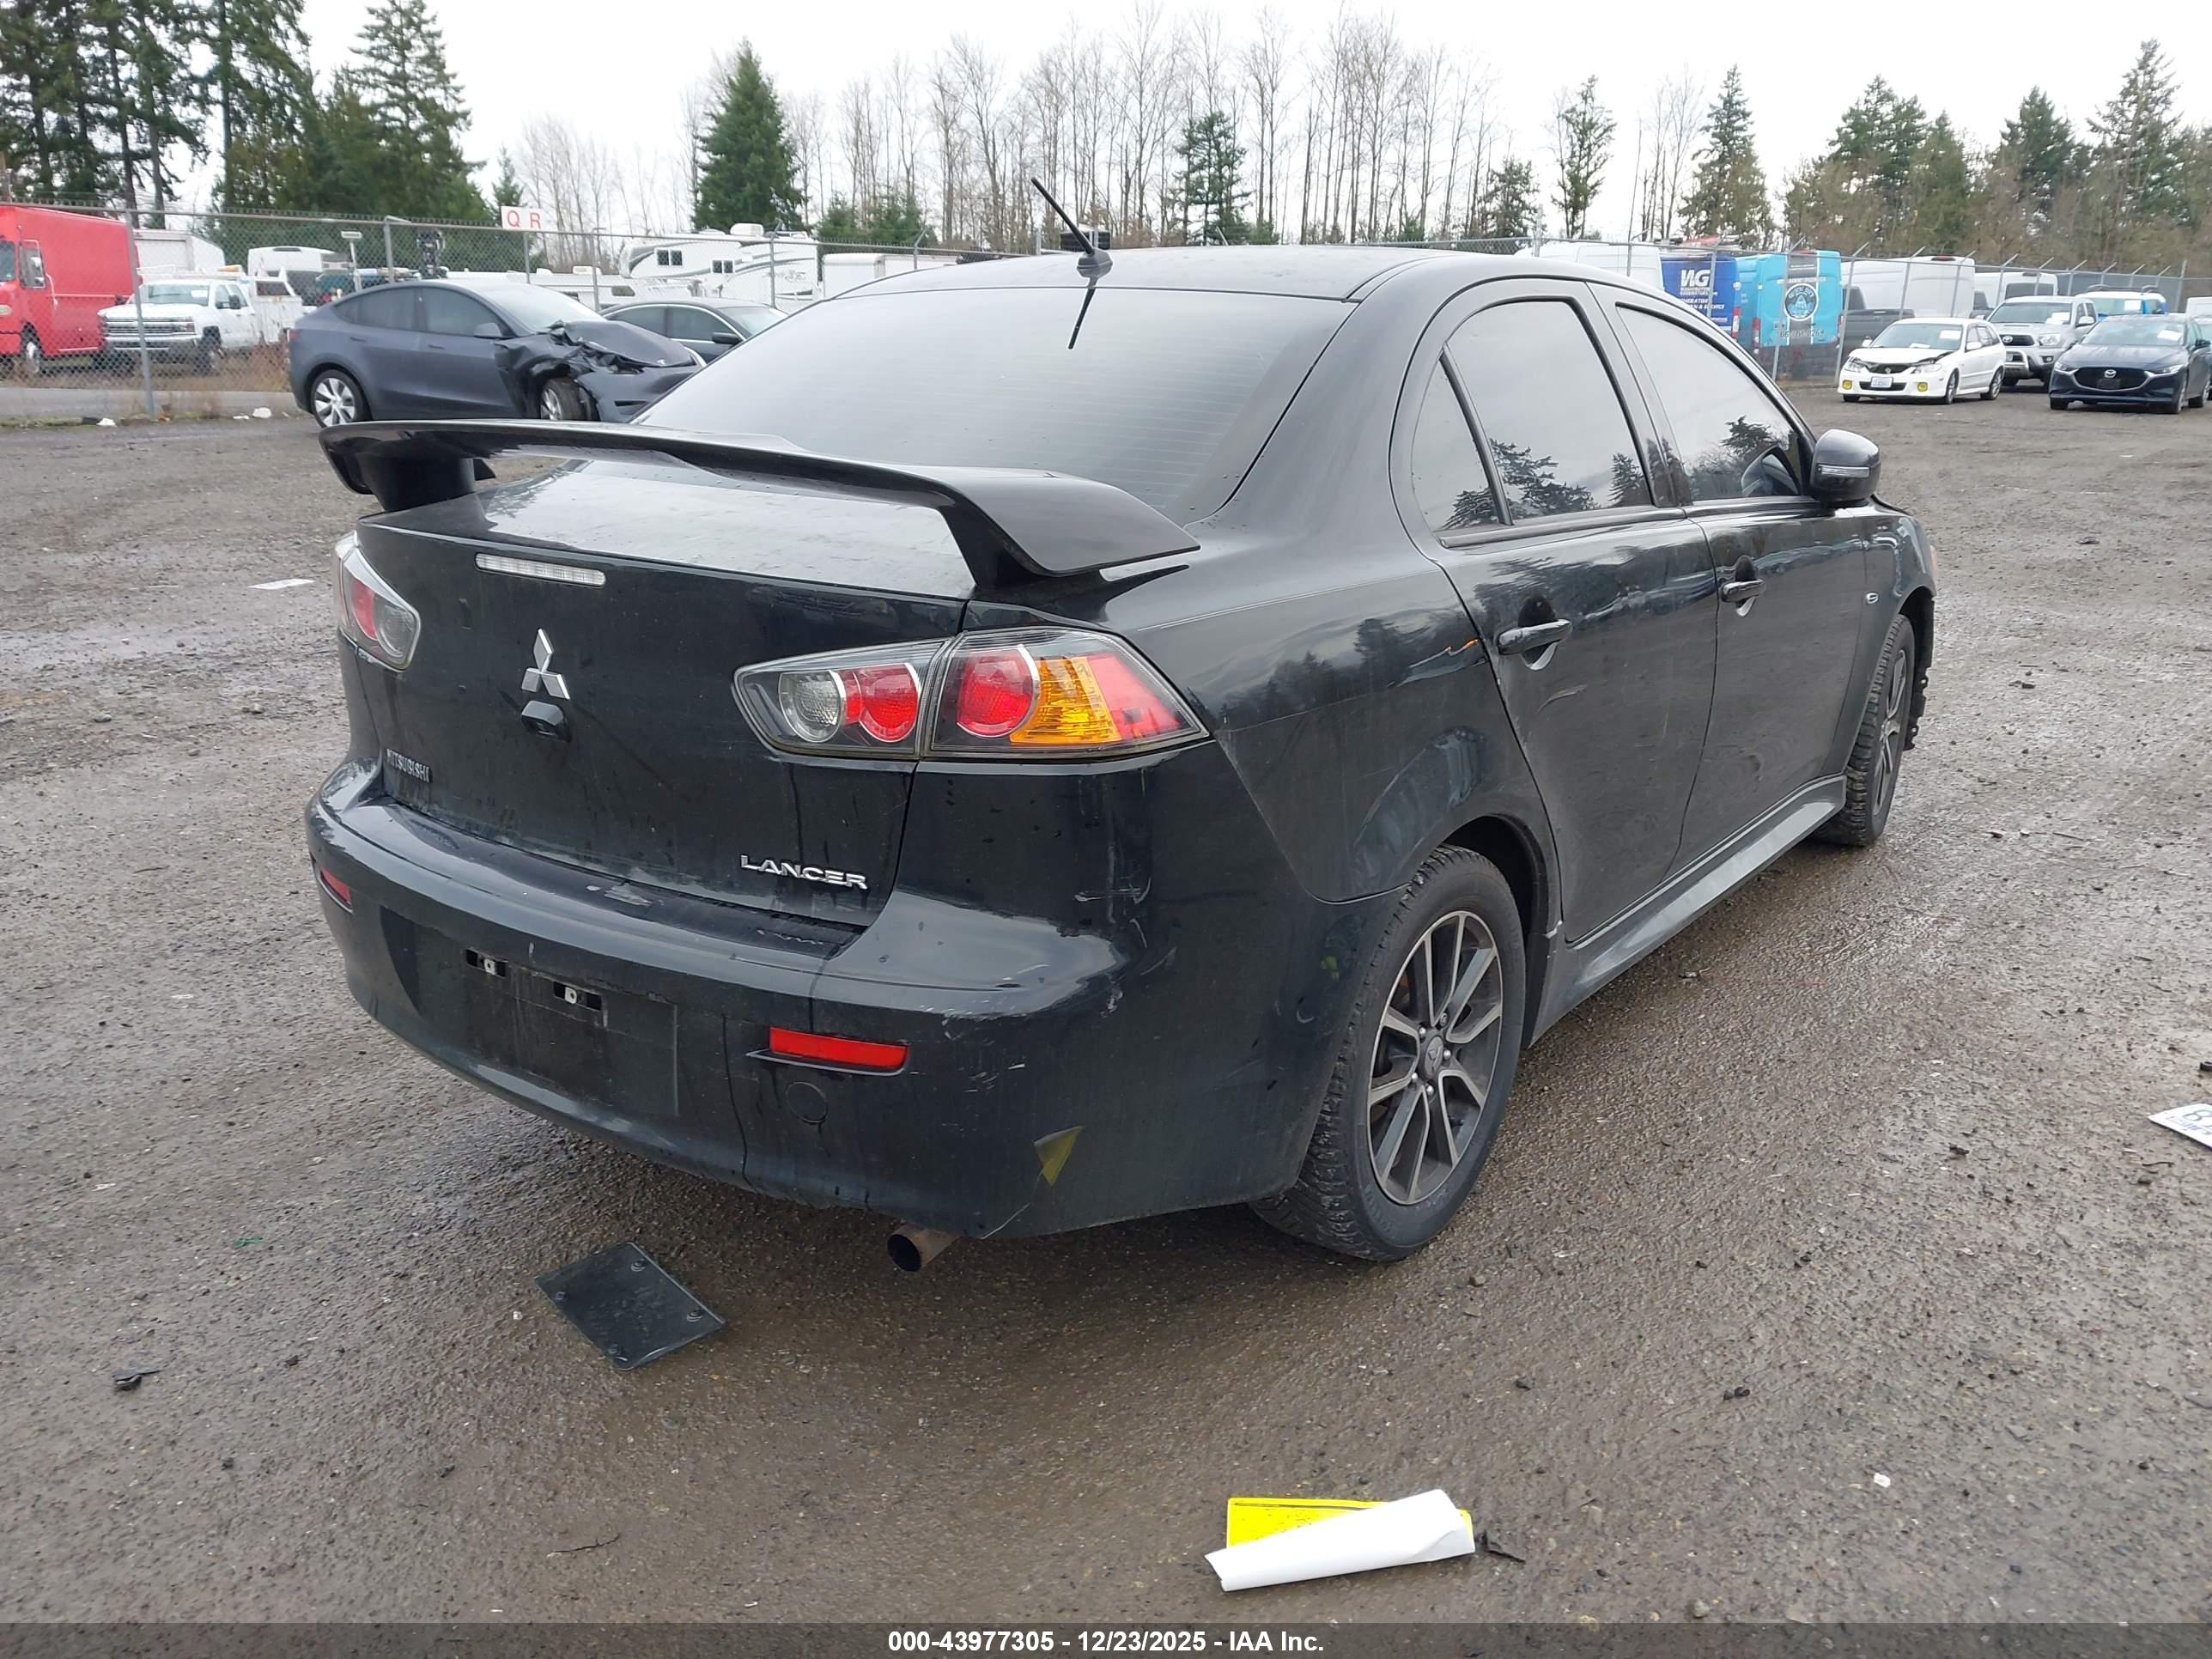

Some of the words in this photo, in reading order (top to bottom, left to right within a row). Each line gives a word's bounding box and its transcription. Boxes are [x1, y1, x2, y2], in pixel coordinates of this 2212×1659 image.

[507, 210, 520, 228] Q
[530, 212, 541, 228] R
[740, 854, 868, 890] LANCER
